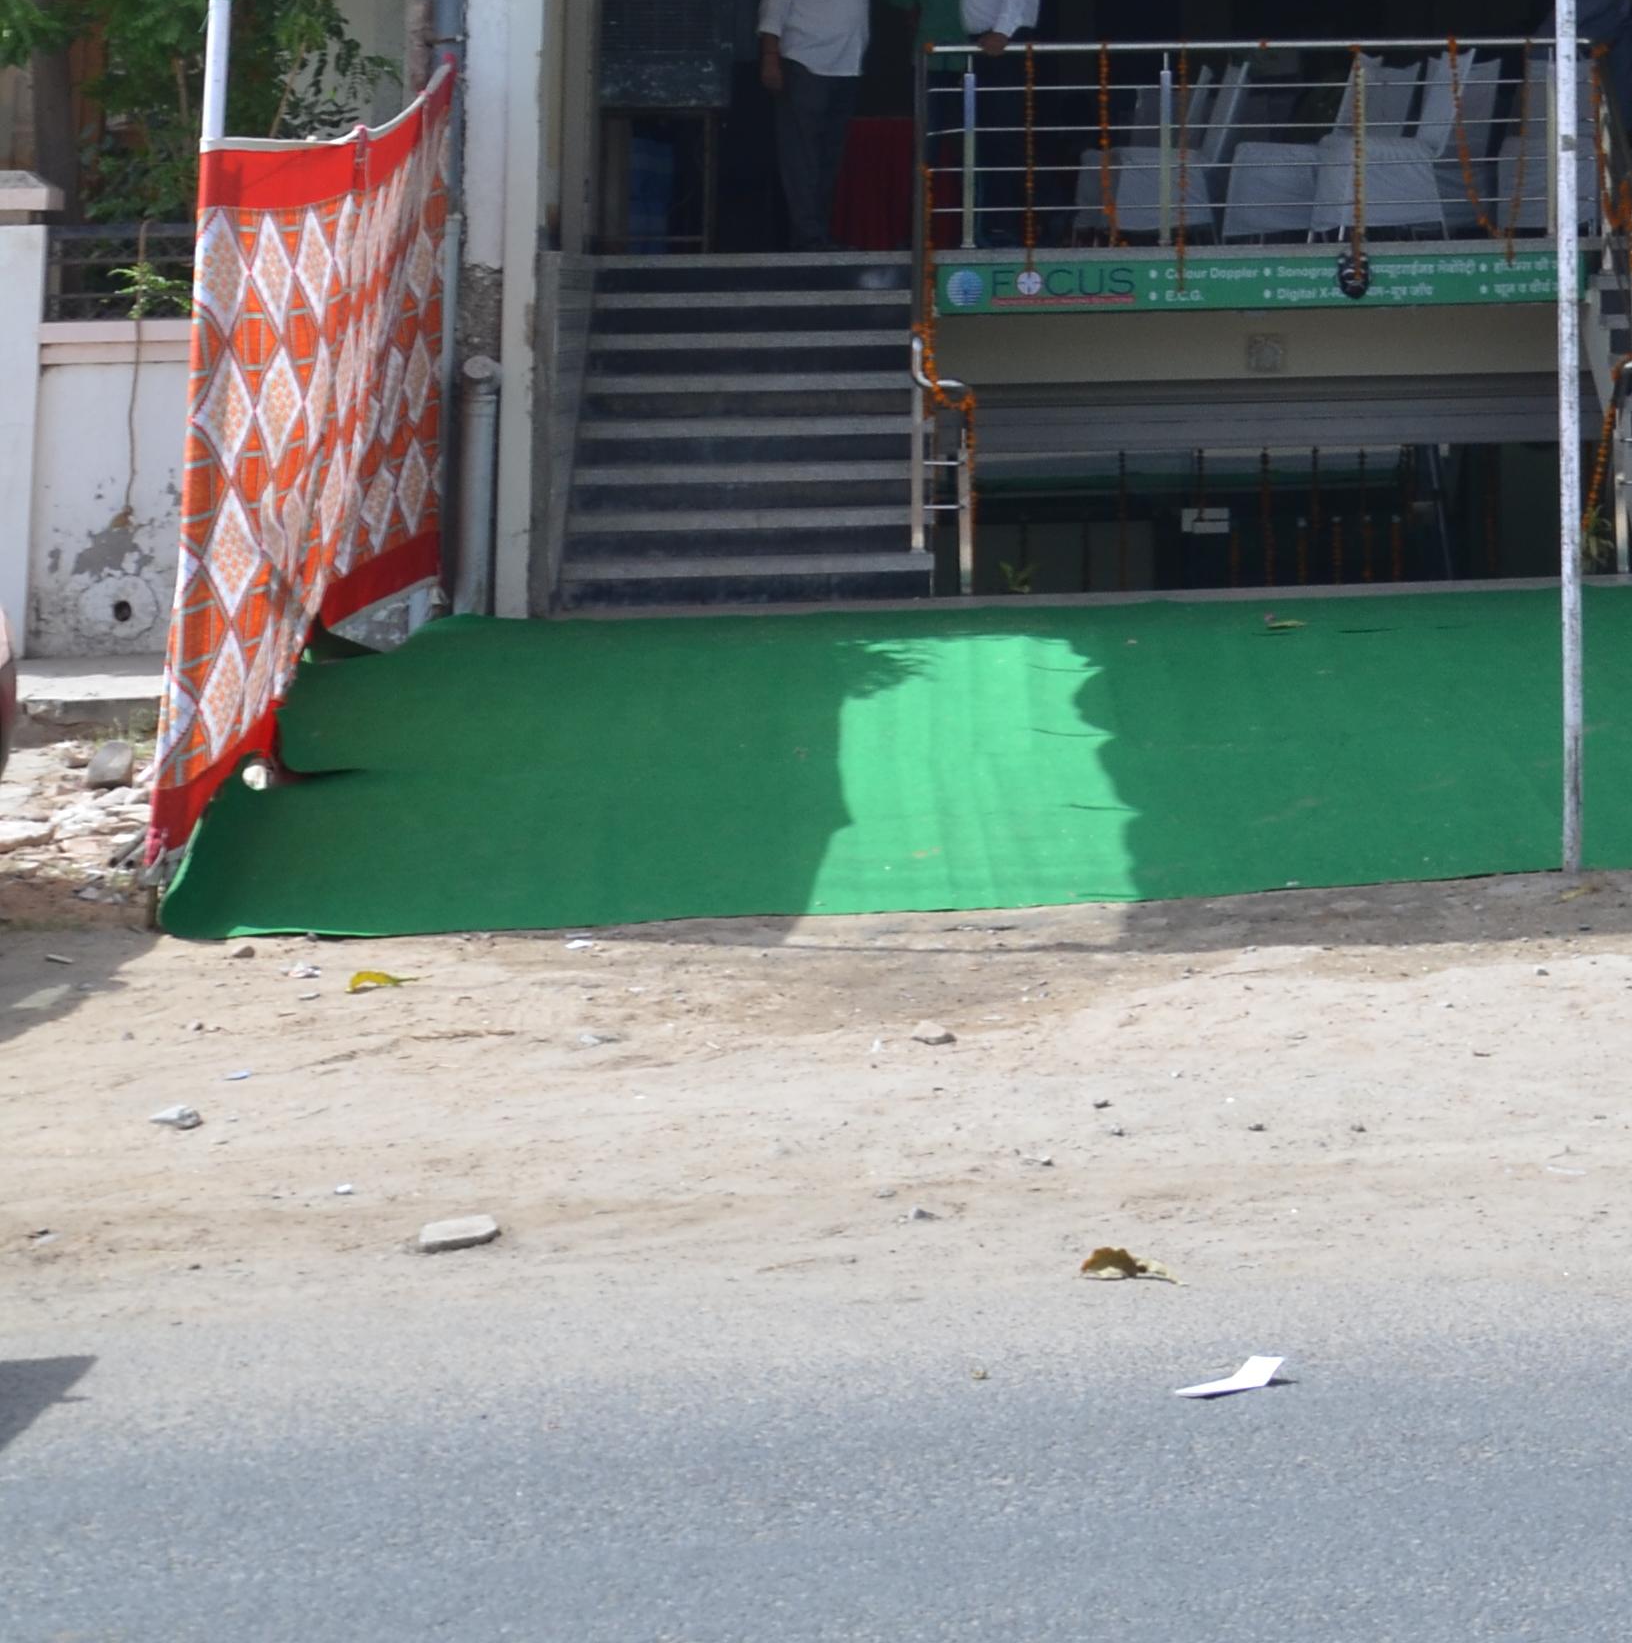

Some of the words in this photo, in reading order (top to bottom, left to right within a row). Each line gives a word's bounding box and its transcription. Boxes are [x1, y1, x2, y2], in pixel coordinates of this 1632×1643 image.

[1209, 266, 1259, 281] Doppler
[991, 267, 1136, 297] FOCUS
[1276, 287, 1316, 301] Digital
